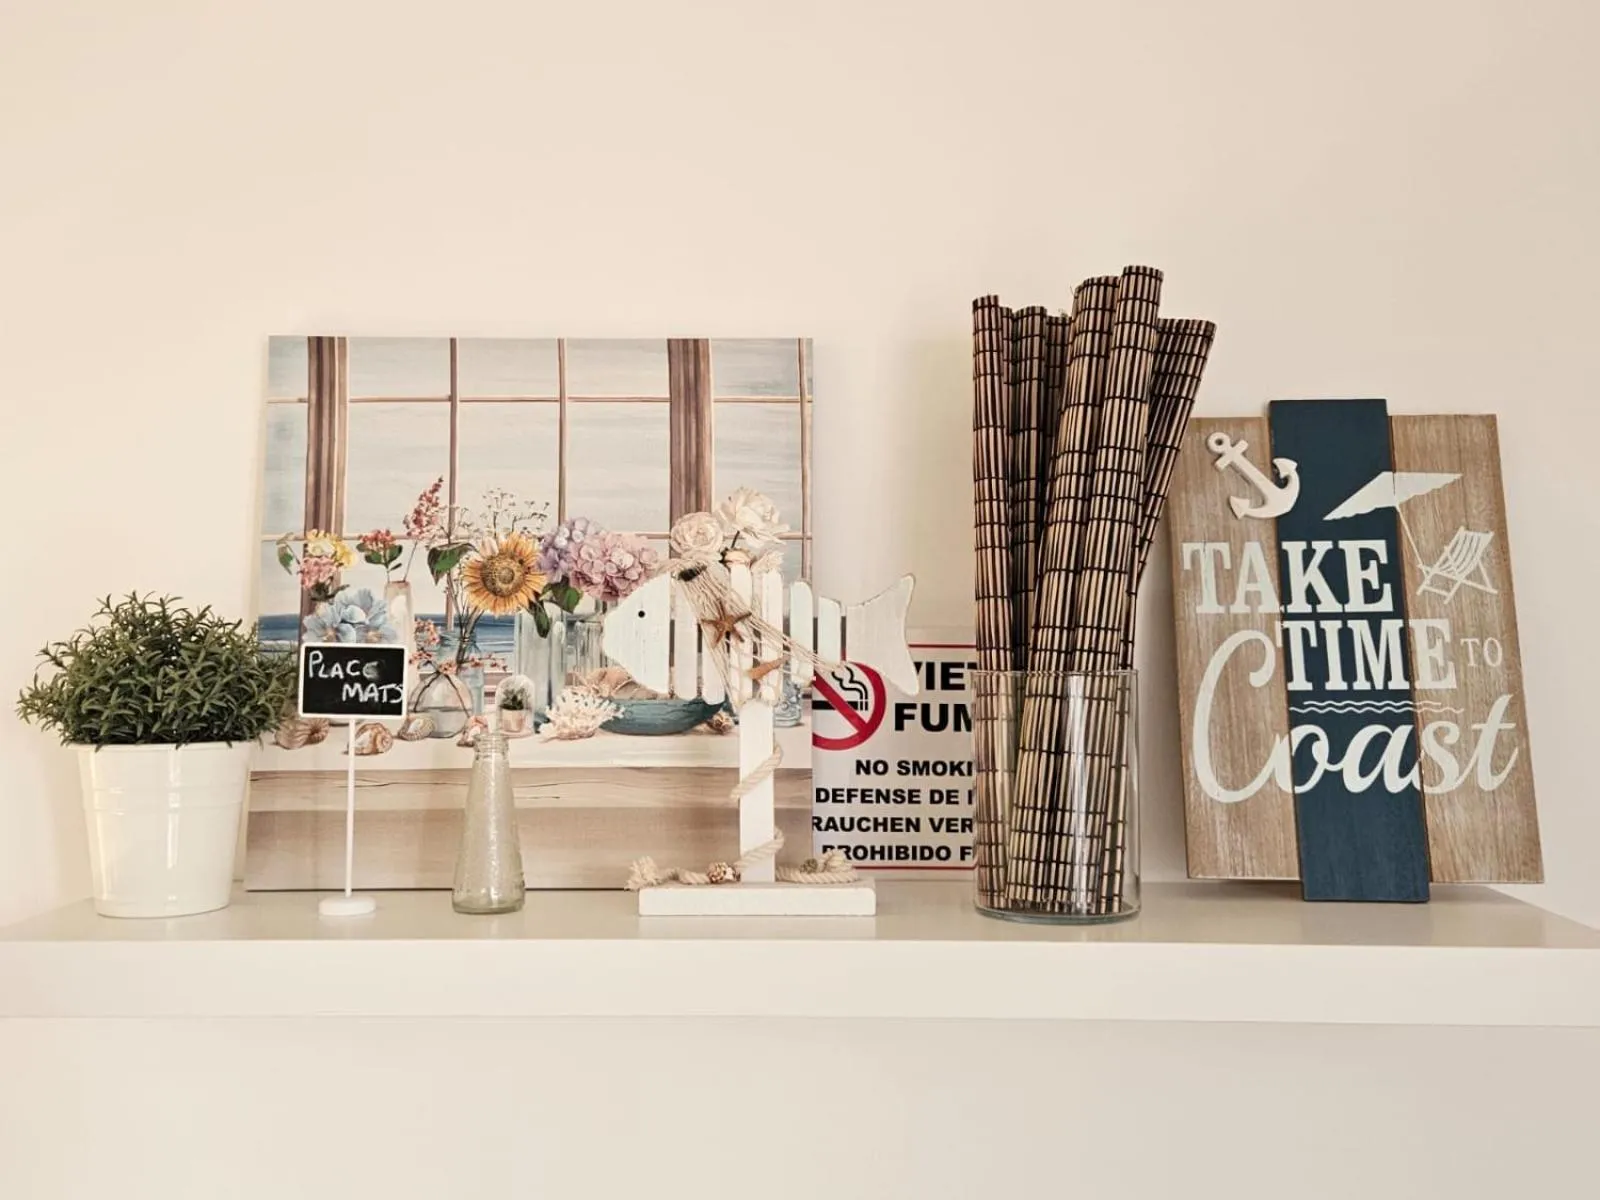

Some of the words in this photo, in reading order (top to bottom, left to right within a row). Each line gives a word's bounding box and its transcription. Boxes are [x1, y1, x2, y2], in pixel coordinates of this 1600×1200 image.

[1183, 539, 1394, 614] TAKE
[1275, 618, 1458, 691] TIME
[1460, 637, 1503, 668] TO
[914, 661, 978, 691] IE
[341, 683, 402, 703] MATS
[1192, 629, 1519, 804] Coast
[855, 759, 889, 776] NO
[815, 787, 921, 805] DEFENSE
[929, 789, 960, 805] DE
[811, 815, 921, 833] RAUCHEN
